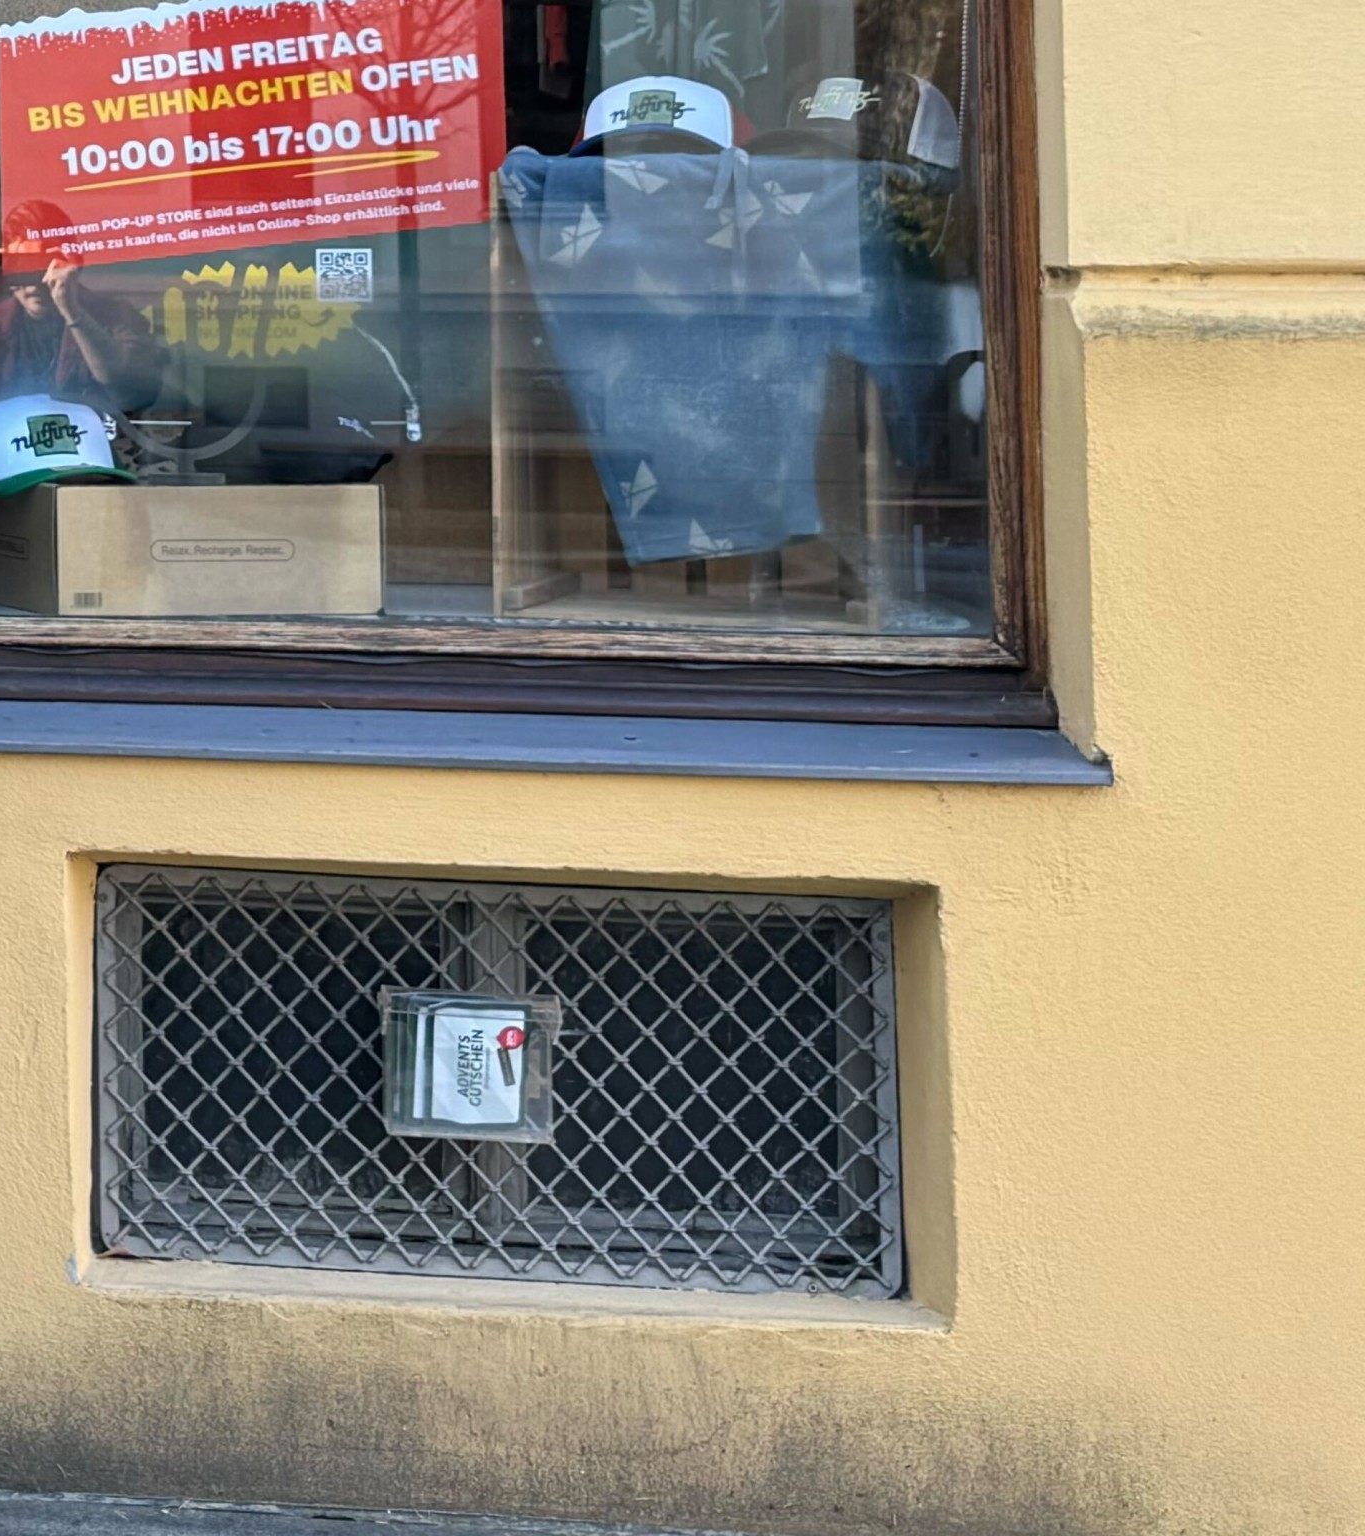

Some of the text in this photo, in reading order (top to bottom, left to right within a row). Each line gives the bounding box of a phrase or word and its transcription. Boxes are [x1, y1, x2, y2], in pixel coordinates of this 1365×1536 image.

[111, 28, 383, 85] JEDEN FREITAG
[28, 53, 478, 132] BIS WEIHNACHTEN OFFEN
[610, 96, 696, 123] nuffinz
[62, 115, 441, 176] 10:00 bis 17:00 Uhr
[42, 223, 100, 238] unserem
[102, 217, 153, 231] POP-UP
[157, 209, 202, 225] STORE
[205, 205, 233, 219] sind
[236, 202, 269, 215] auch
[270, 197, 322, 212] seltene
[324, 185, 414, 205] Einzelstücke
[416, 182, 443, 195] und
[445, 178, 479, 190] viele
[61, 200, 446, 255] Styles zu kaufen, die nicht im Online-Shop erhältlich sind.
[11, 420, 88, 452] nuffinz
[457, 1035, 470, 1098] ADVENTS
[469, 1029, 484, 1107] GUTSCHEIN
